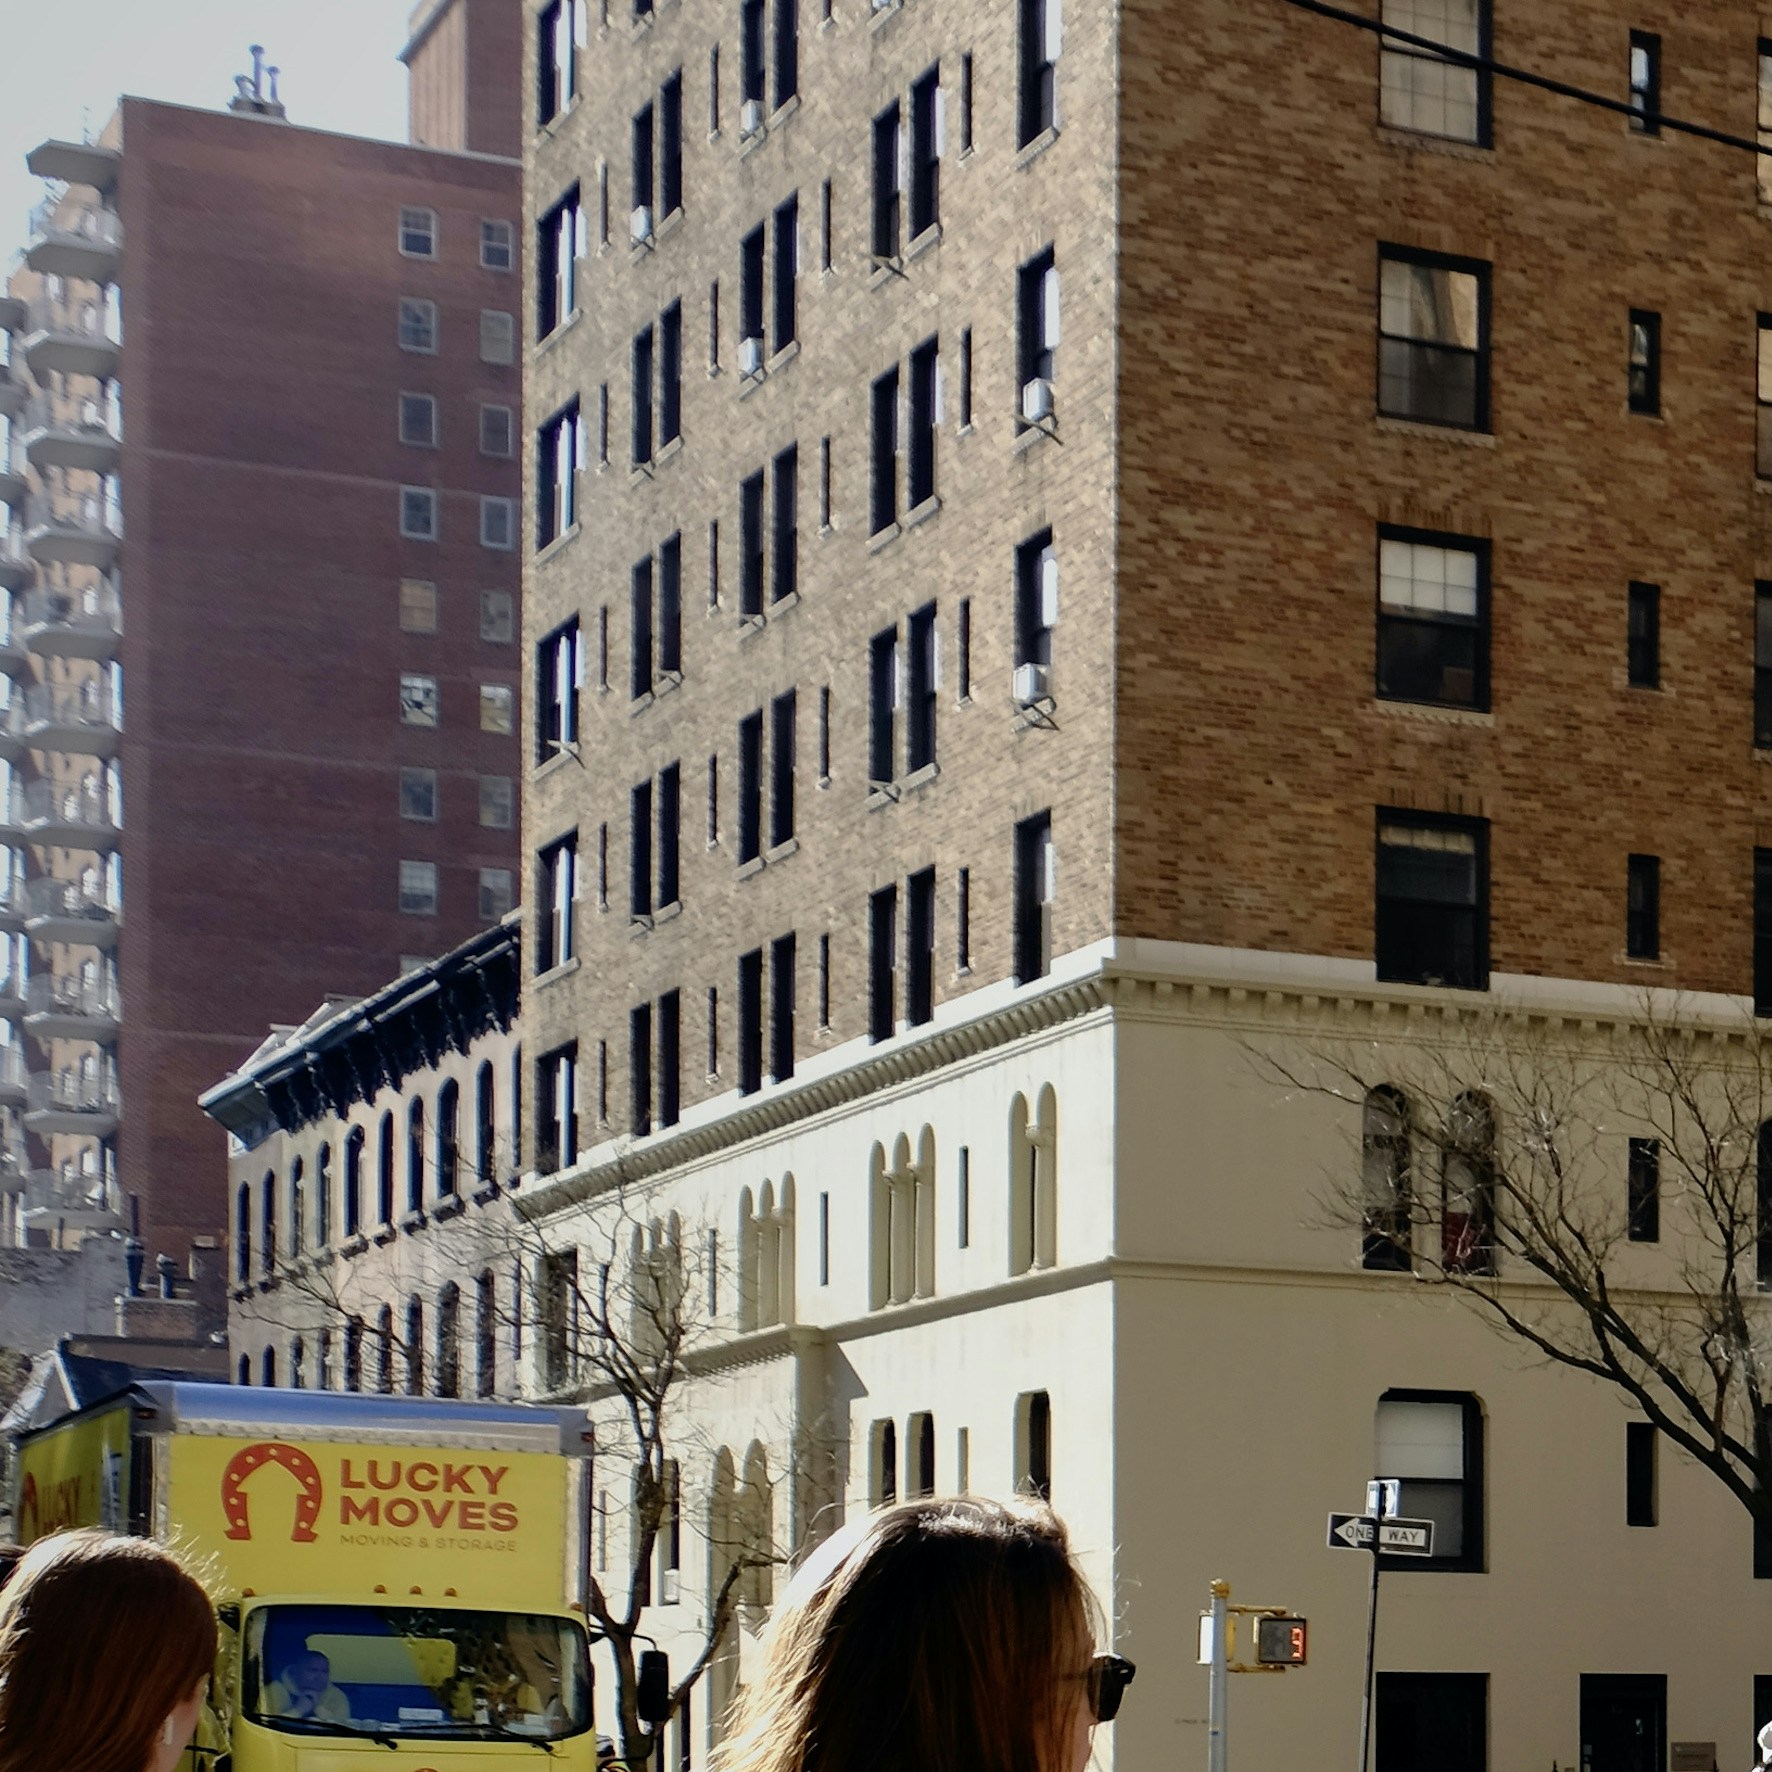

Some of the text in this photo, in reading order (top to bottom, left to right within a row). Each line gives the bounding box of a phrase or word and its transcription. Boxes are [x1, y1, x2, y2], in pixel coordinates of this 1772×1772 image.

[341, 1458, 509, 1496] LUCKY
[340, 1495, 519, 1532] MOVES
[340, 1534, 518, 1553] MOVING & STORAGE
[1345, 1525, 1419, 1543] ONE WAY
